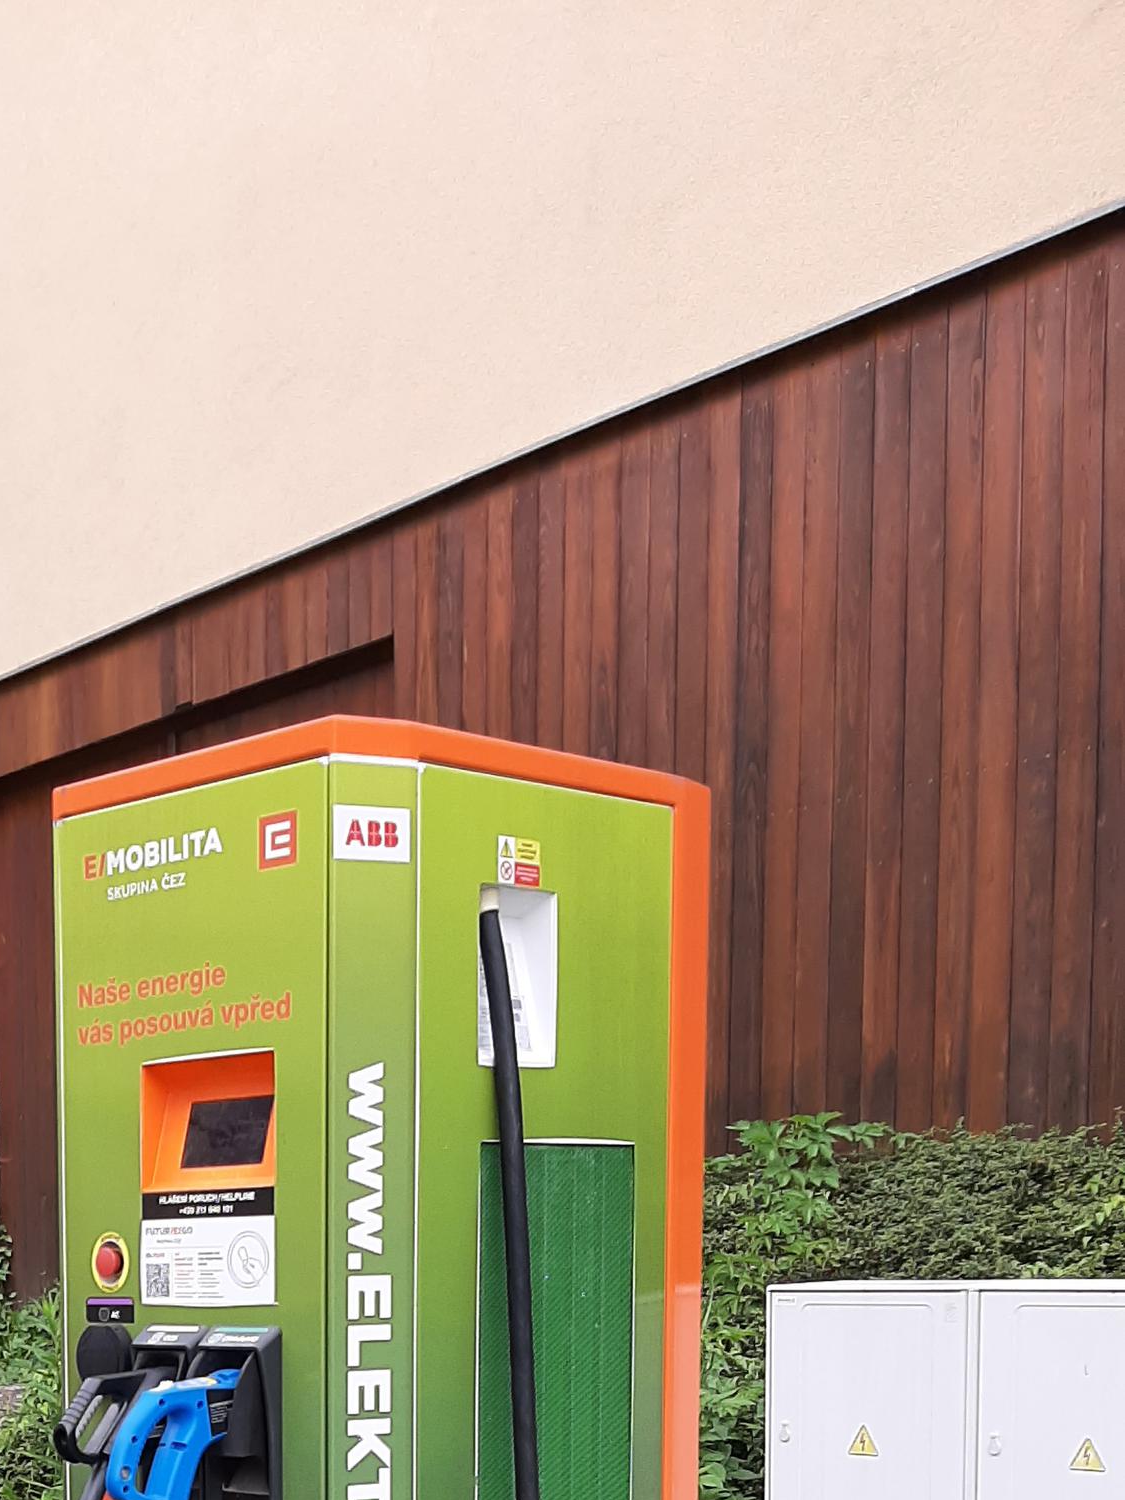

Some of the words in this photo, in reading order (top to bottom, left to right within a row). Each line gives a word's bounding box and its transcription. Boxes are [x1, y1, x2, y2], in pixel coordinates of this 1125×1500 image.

[345, 819, 400, 848] ABB
[107, 877, 159, 901] SKUPINA
[161, 872, 187, 890] ČEZ
[78, 977, 131, 1008] Naše
[137, 961, 226, 999] energie
[78, 1018, 114, 1045] vás
[119, 1000, 214, 1046] posouvá
[220, 991, 292, 1029] vpřed
